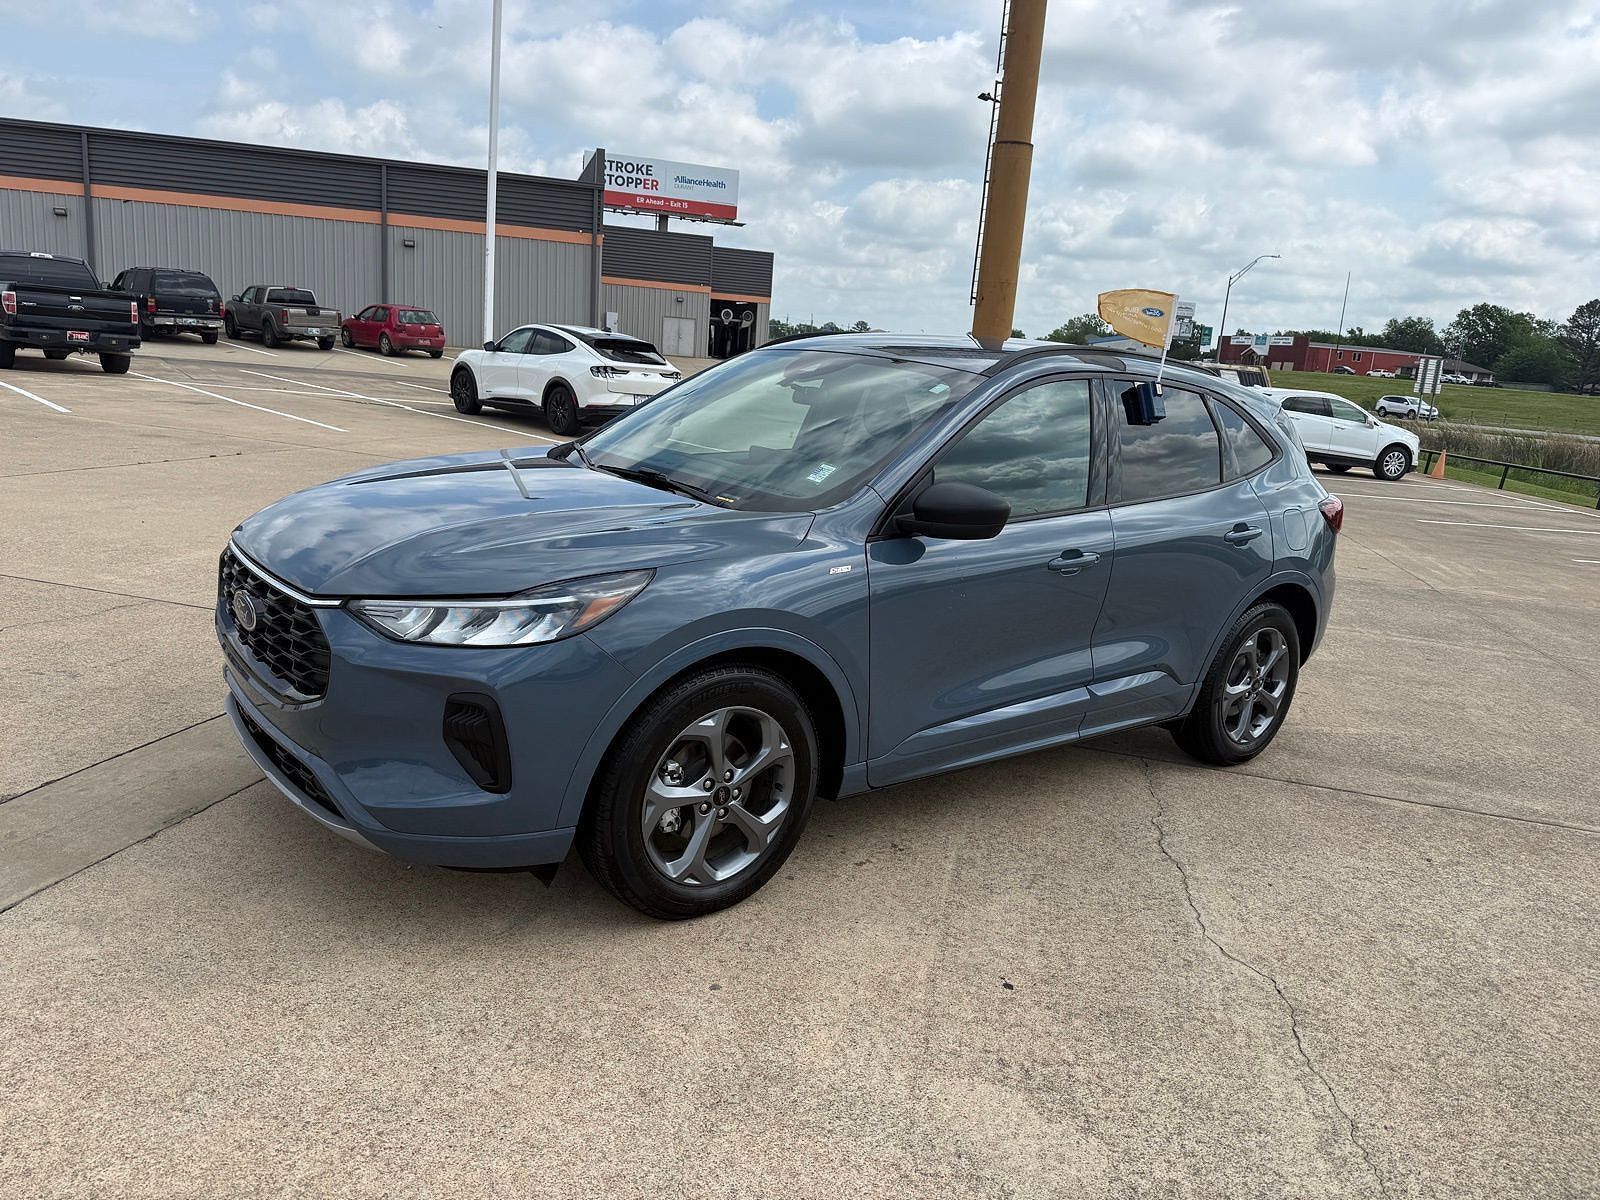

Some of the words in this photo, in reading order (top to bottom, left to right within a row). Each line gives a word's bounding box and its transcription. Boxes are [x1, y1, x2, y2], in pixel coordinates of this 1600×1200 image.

[674, 175, 726, 189] AllianceHealth
[645, 198, 664, 206] Ahead
[670, 200, 682, 208] Exit
